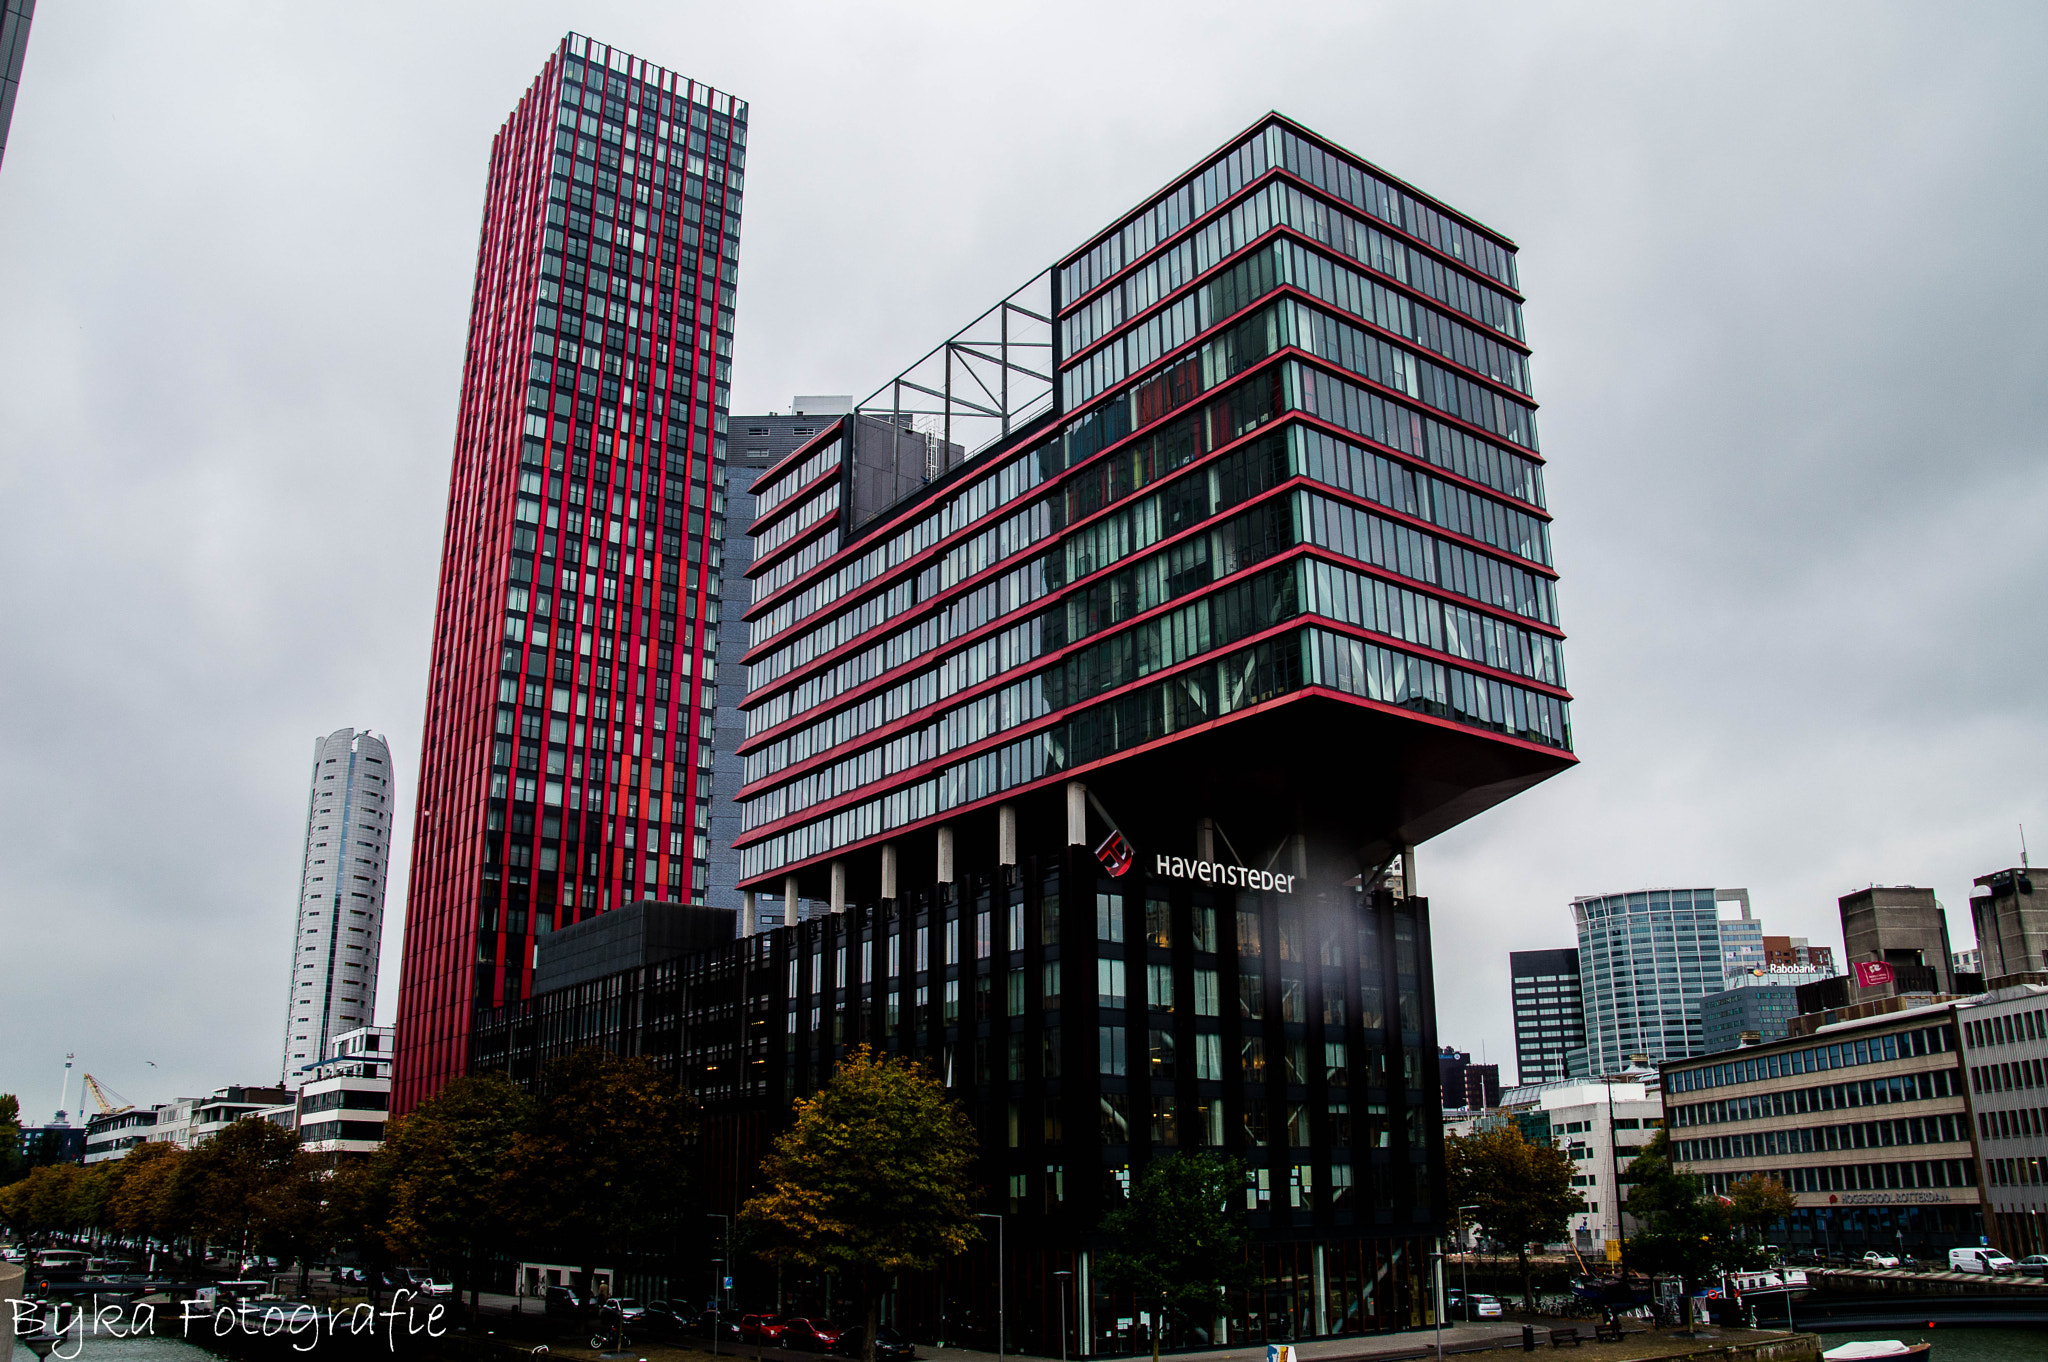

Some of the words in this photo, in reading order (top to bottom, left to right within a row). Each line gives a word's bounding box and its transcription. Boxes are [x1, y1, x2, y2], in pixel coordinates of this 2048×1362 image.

[1770, 963, 1816, 974] Rabobank
[1841, 1193, 1895, 1205] HOGESCHOOL
[1896, 1190, 1951, 1203] ROTTERDAM
